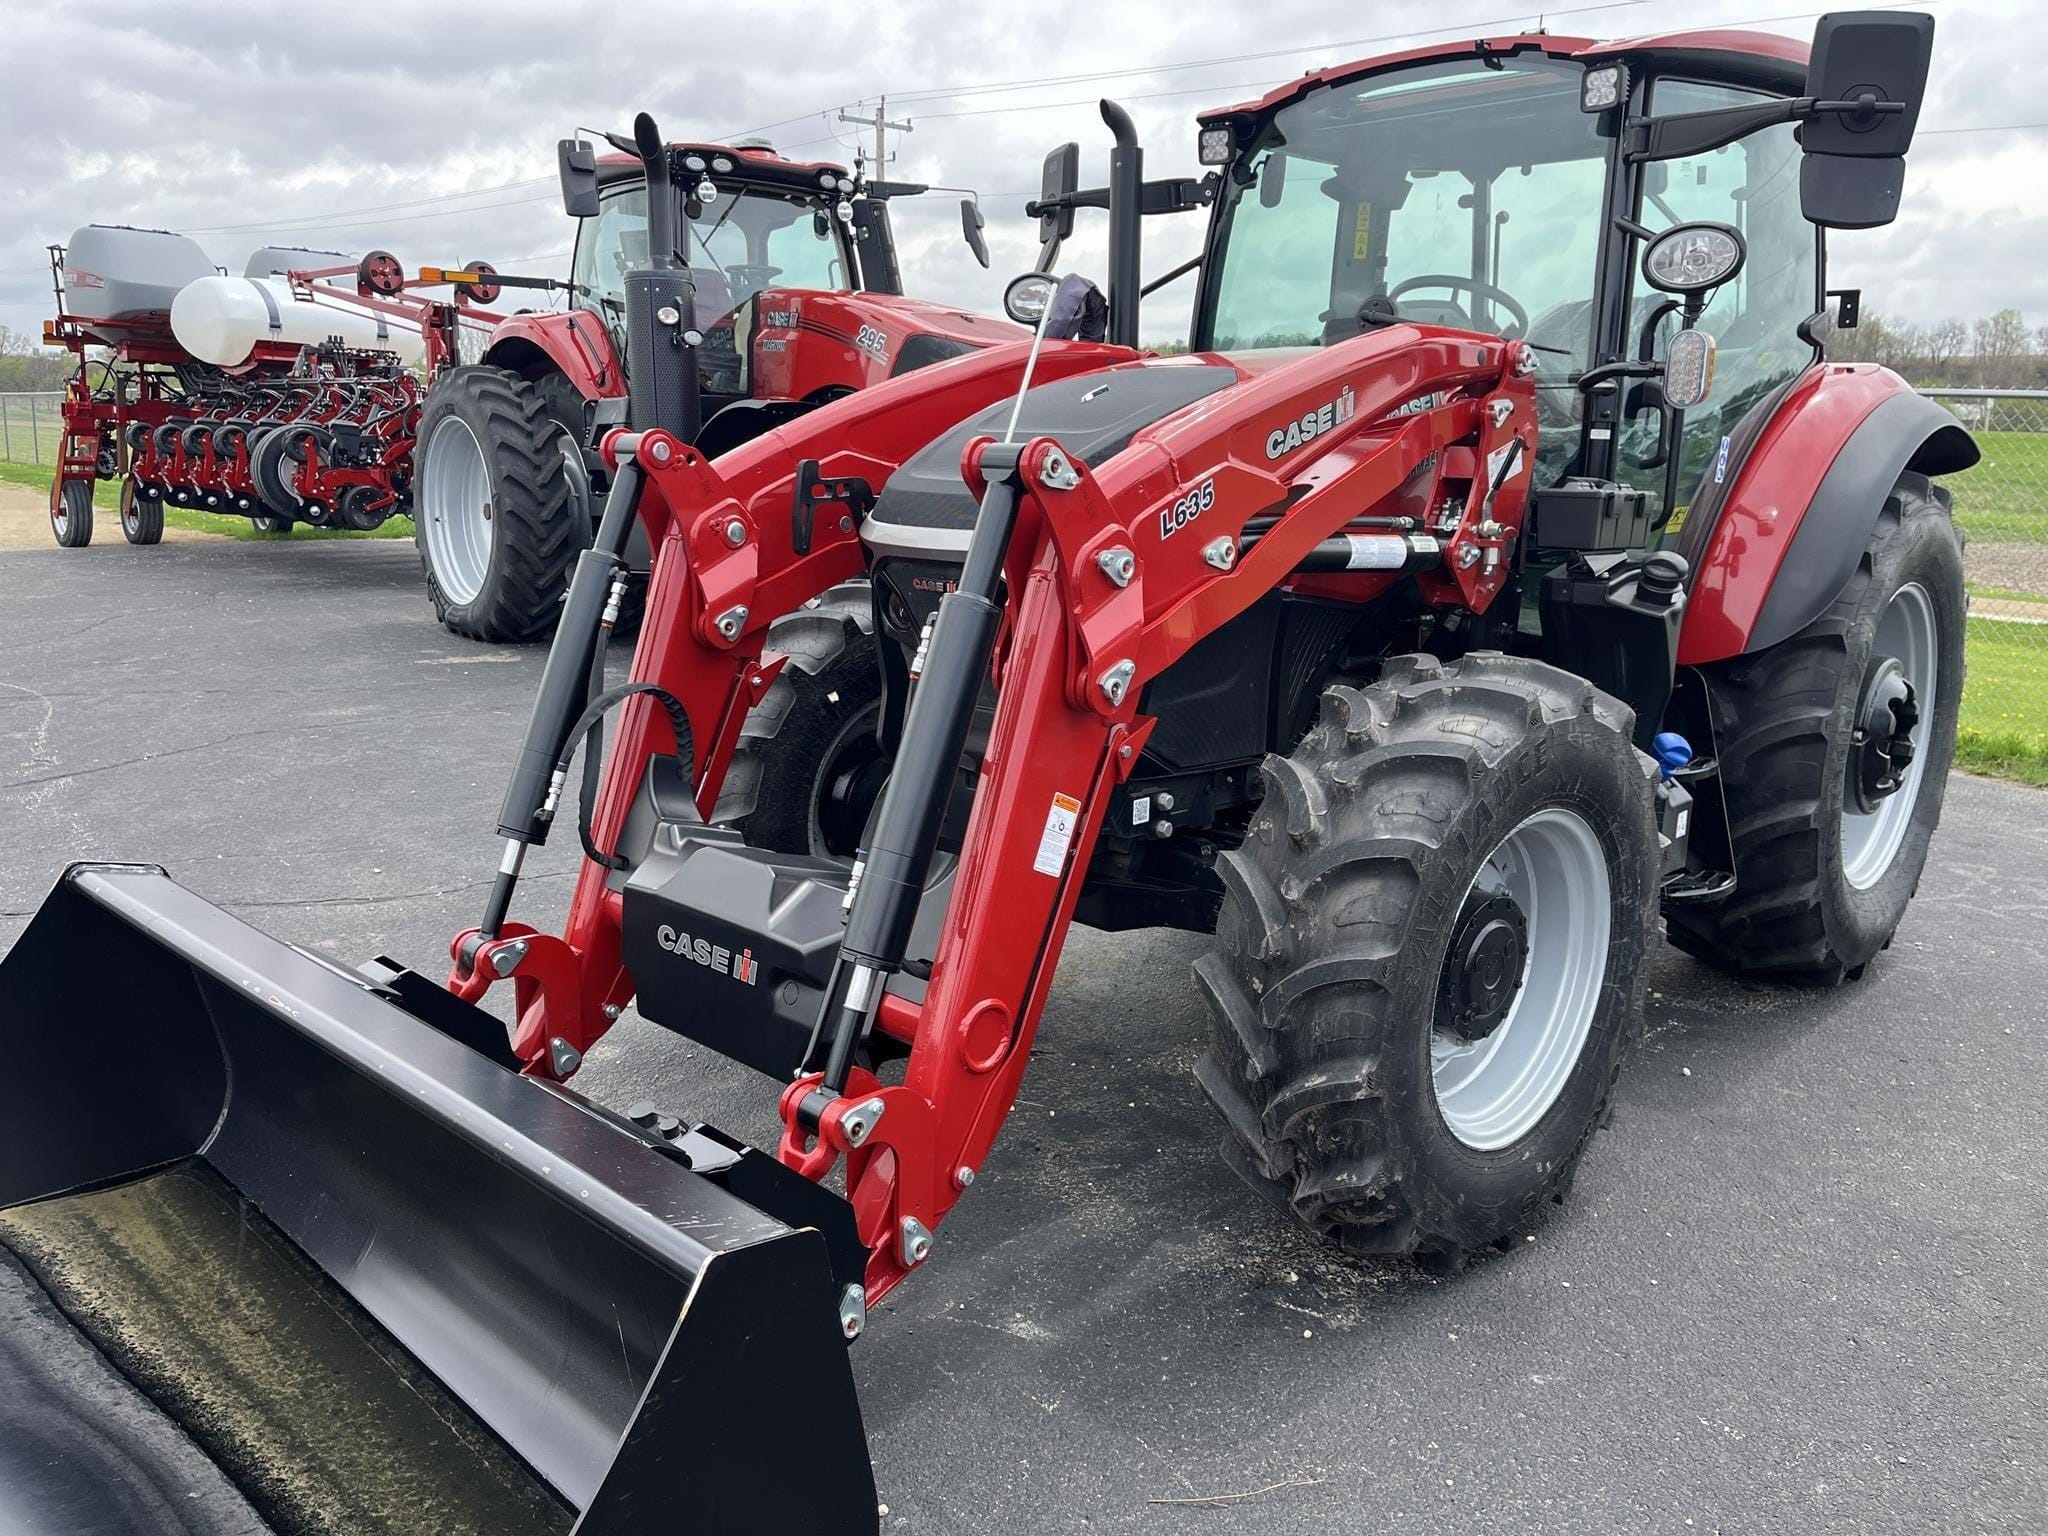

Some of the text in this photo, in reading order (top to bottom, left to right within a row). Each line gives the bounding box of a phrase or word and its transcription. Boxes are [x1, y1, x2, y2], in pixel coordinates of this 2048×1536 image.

[768, 311, 789, 326] CASE
[856, 324, 887, 353] 295
[1266, 403, 1332, 460] CASE
[1160, 479, 1215, 541] L635
[912, 578, 944, 592] CASE
[657, 924, 731, 974] CASE
